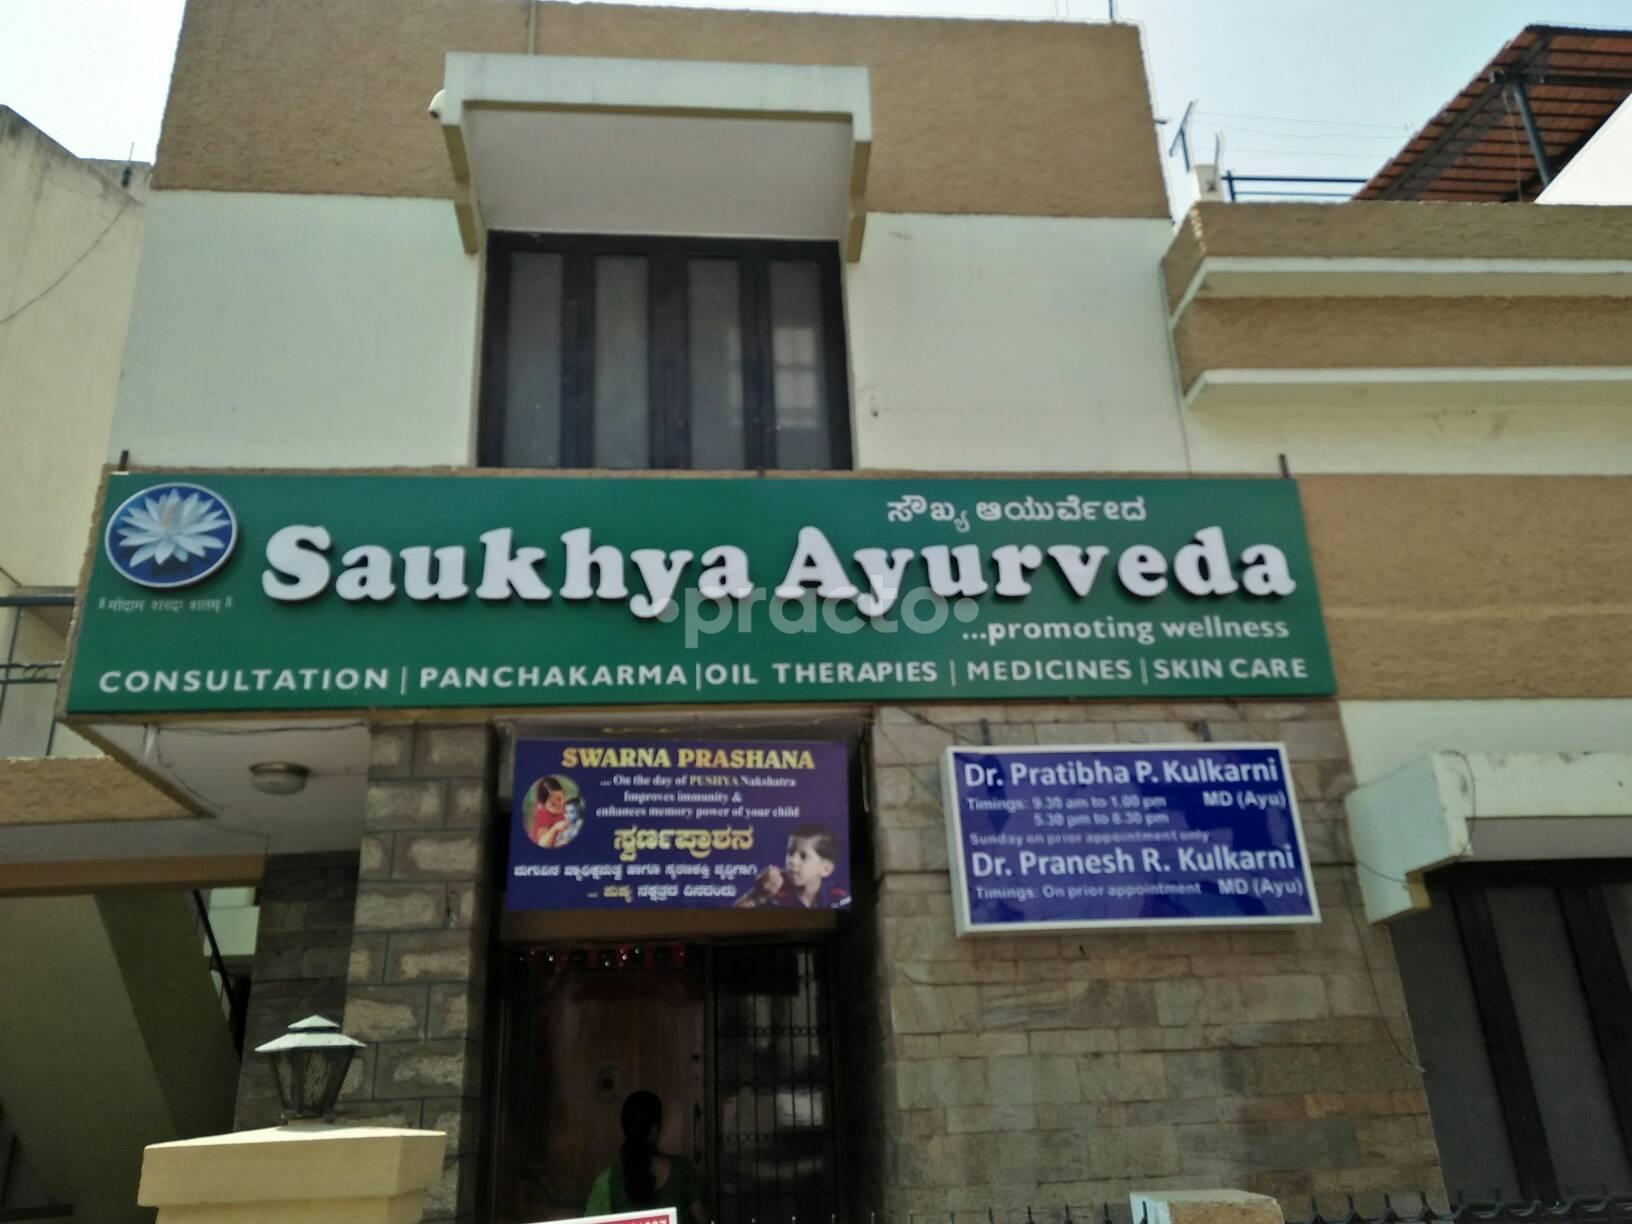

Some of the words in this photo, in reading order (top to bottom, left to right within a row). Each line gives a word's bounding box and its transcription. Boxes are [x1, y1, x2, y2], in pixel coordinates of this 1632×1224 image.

[887, 494, 971, 533] ಸೌಖ್ಯ
[975, 495, 1147, 521] ಆಯುರ್ವೇದ
[262, 524, 753, 619] Saukhya
[774, 525, 1296, 617] Ayurveda
[1161, 616, 1289, 638] wellness
[99, 667, 389, 694] CONSULTATION
[419, 664, 688, 689] PANCHAKARMA
[705, 664, 758, 685] OIL
[772, 661, 938, 684] THERAPIES
[967, 659, 1132, 682] MEDICINES
[1153, 658, 1223, 680] SKIN
[1228, 657, 1309, 680] CARE
[561, 747, 671, 769] SWARNA
[677, 749, 816, 770] PRASHANA
[633, 774, 651, 787] the
[652, 774, 673, 789] day
[675, 774, 688, 787] of
[689, 775, 739, 787] PUSHYA
[740, 775, 797, 788] Nakshatra
[964, 762, 1005, 787] Dr.
[1010, 759, 1131, 786] Pratibha
[1135, 760, 1160, 783] P.
[1162, 757, 1279, 784] Kulkarni
[624, 790, 675, 805] Improves
[677, 791, 728, 805] immunity
[731, 791, 743, 804] &
[1031, 796, 1063, 810] 9.30
[1065, 798, 1089, 809] am
[1090, 796, 1108, 809] to
[1110, 794, 1140, 808] 1.00
[1142, 796, 1167, 811] pm
[1202, 790, 1233, 807] MD
[1236, 790, 1287, 810] (Ayu)
[595, 805, 647, 818] enhances
[648, 807, 694, 820] memory
[695, 806, 729, 820] power
[731, 805, 744, 818] of
[744, 807, 771, 820] your
[772, 805, 800, 818] child
[1066, 814, 1091, 829] pm
[1092, 812, 1110, 825] to
[1144, 813, 1170, 827] pm
[969, 832, 1024, 847] Sunday
[1026, 834, 1045, 844] on
[1046, 833, 1082, 846] prior
[1085, 831, 1178, 845] appointment
[1179, 829, 1210, 843] only
[971, 852, 1013, 877] Dr.
[1018, 847, 1135, 876] Pranesh
[1141, 848, 1171, 873] R.
[1177, 844, 1296, 872] Kulkarni
[1042, 885, 1065, 898] On
[1067, 886, 1104, 899] prior
[1107, 883, 1203, 897] appointment
[1217, 878, 1249, 895] MD
[1252, 877, 1304, 898] (Ayu)
